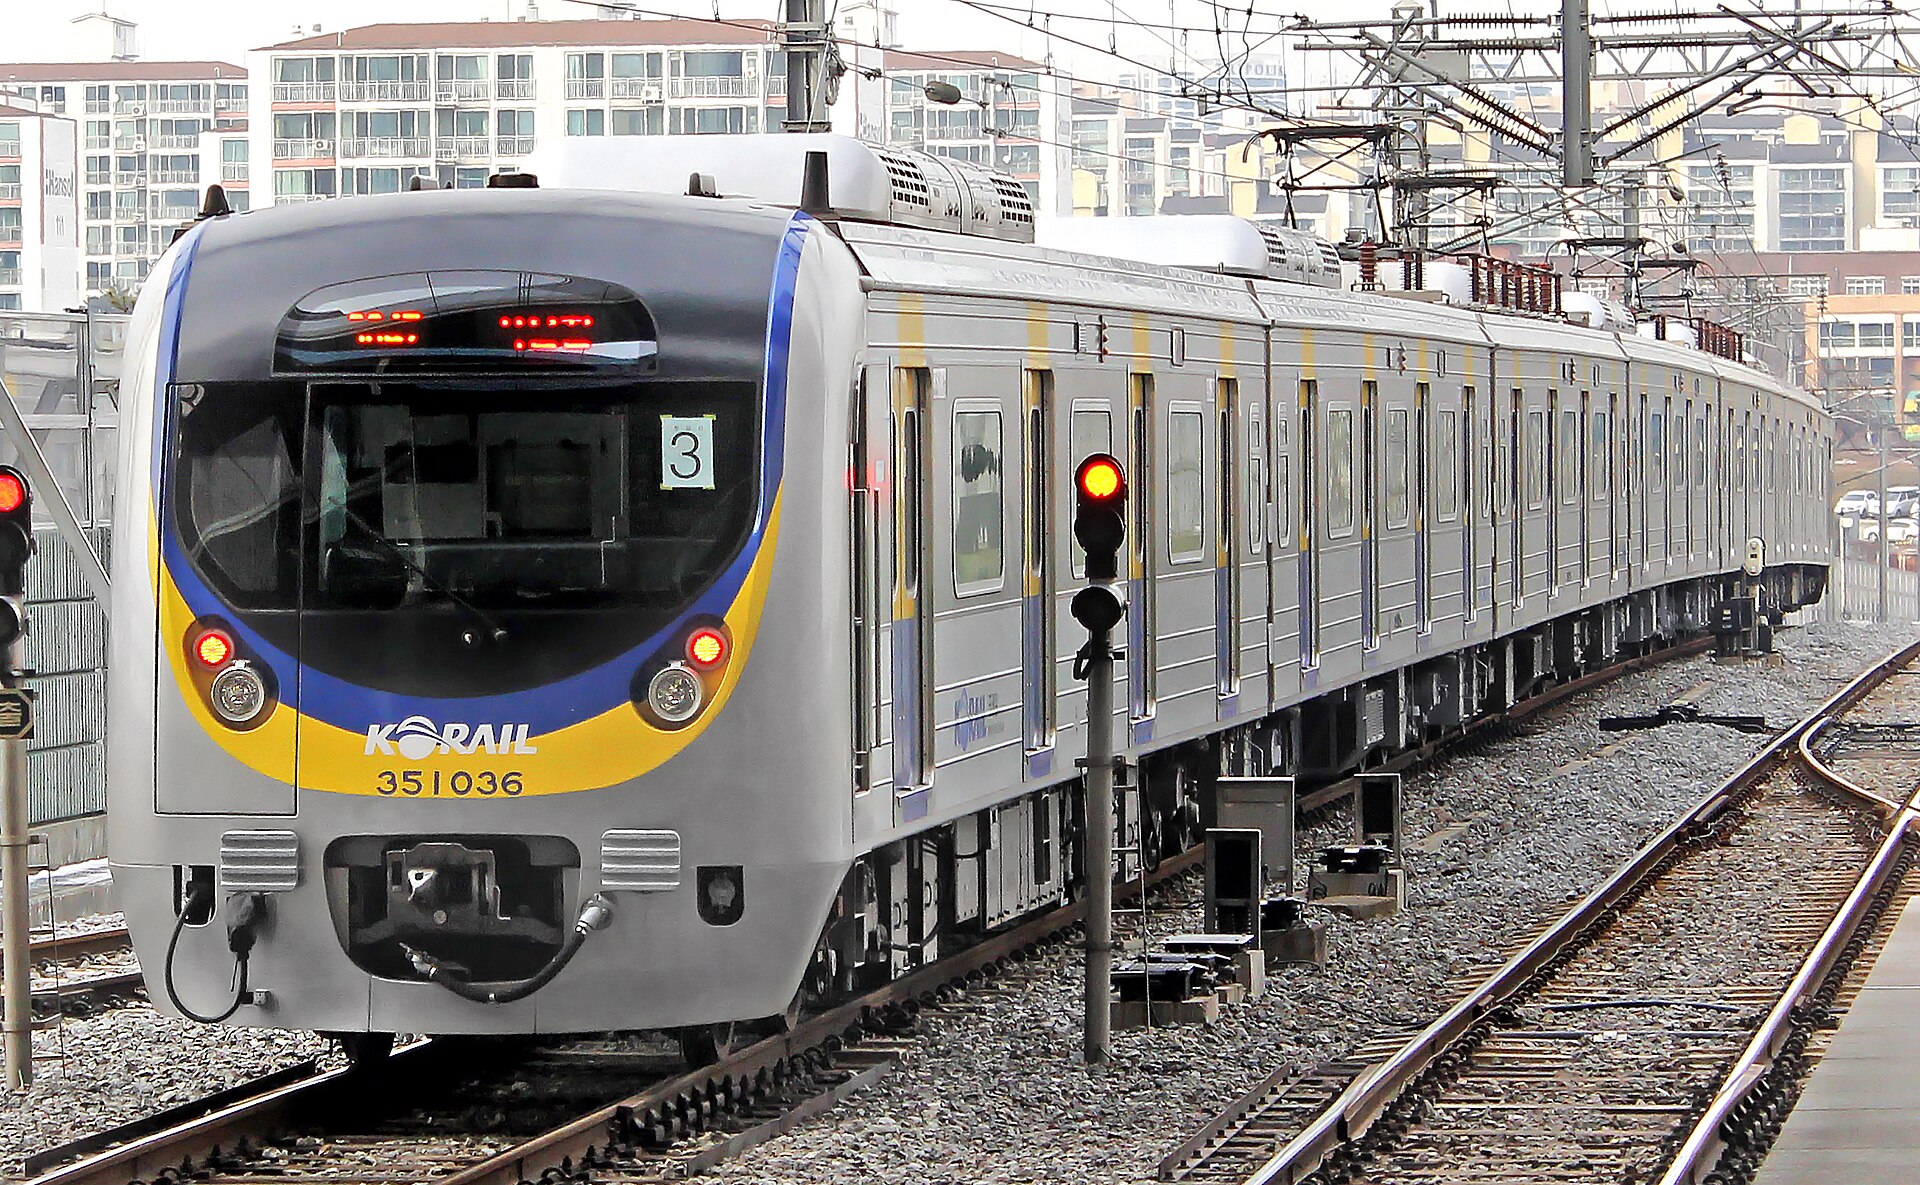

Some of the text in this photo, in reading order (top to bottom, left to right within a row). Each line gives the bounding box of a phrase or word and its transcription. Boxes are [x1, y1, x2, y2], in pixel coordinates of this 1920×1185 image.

[670, 431, 701, 479] 3
[364, 715, 538, 760] KORAIL
[376, 771, 523, 795] 351036
